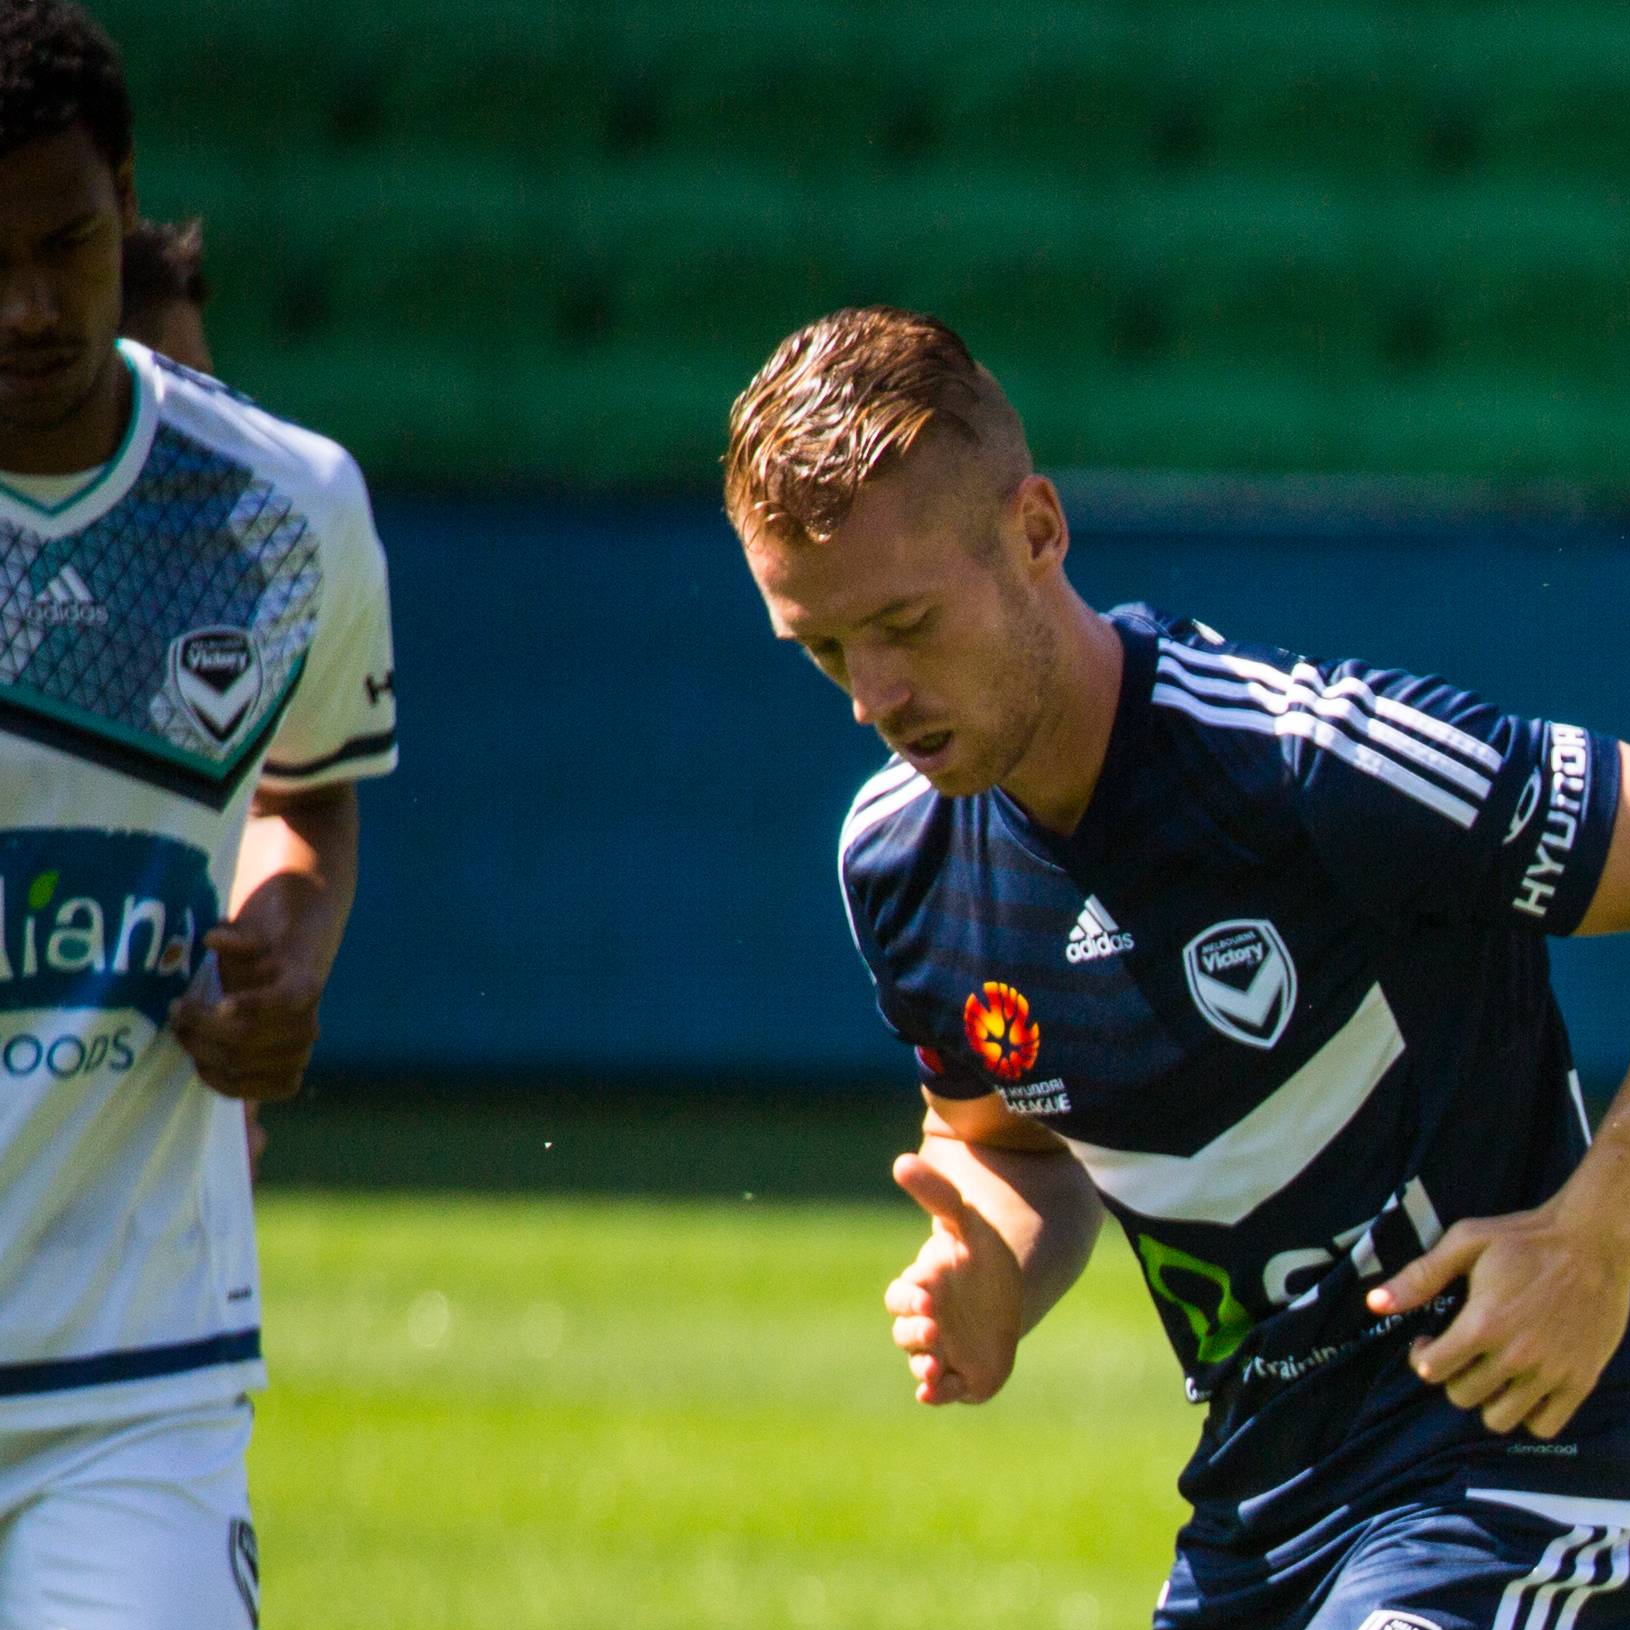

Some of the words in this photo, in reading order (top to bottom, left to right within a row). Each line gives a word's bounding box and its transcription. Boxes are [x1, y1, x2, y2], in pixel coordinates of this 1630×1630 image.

[0, 868, 196, 982] liana
[1065, 931, 1134, 964] adidas
[1202, 942, 1263, 973] Victory
[3, 1022, 135, 1078] OODS
